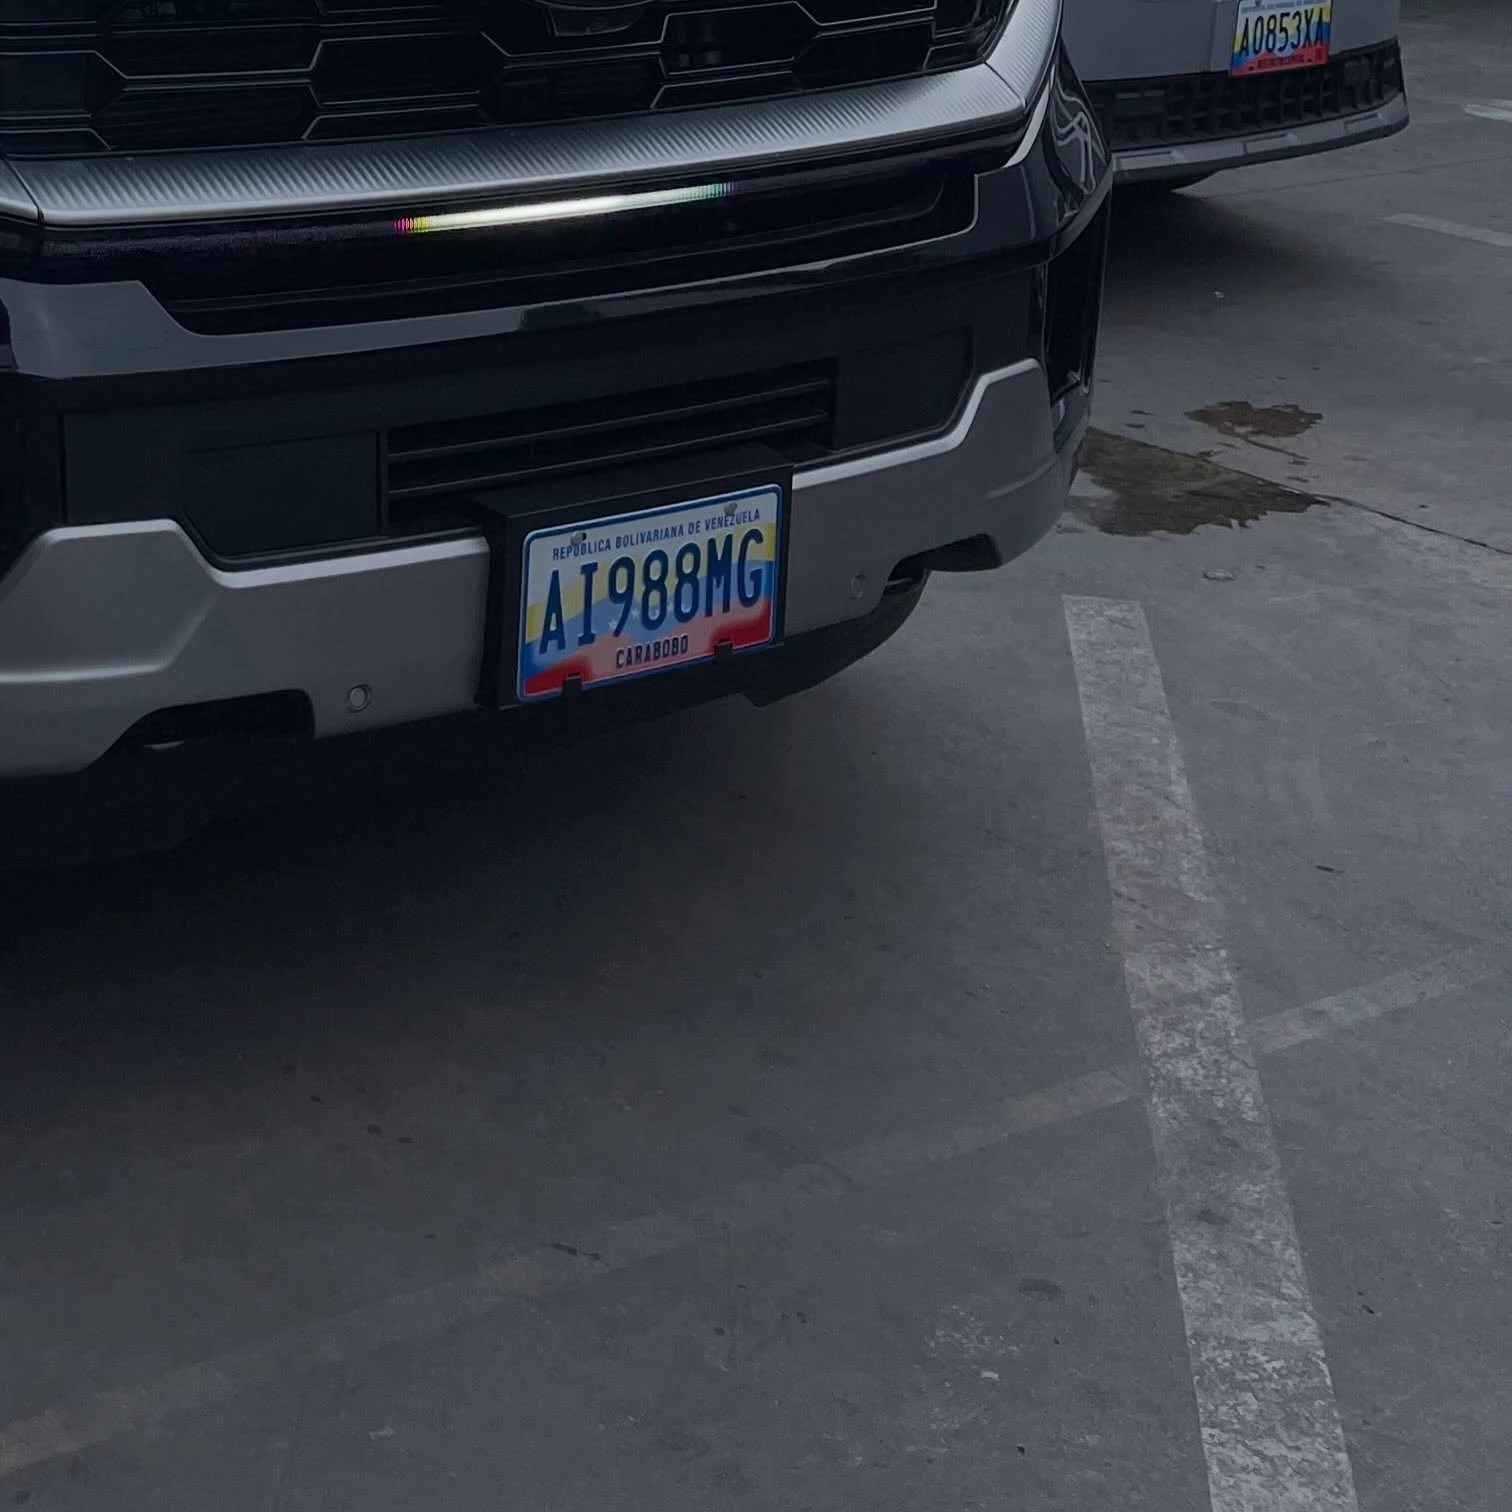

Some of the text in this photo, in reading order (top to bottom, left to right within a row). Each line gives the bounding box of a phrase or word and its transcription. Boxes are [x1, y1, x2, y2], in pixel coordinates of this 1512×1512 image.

[615, 528, 686, 548] BOLIVARIANA
[688, 519, 702, 536] DE
[704, 508, 761, 531] VENEZUELA
[539, 529, 764, 654] AI988MG
[615, 635, 689, 669] CARABOBO
